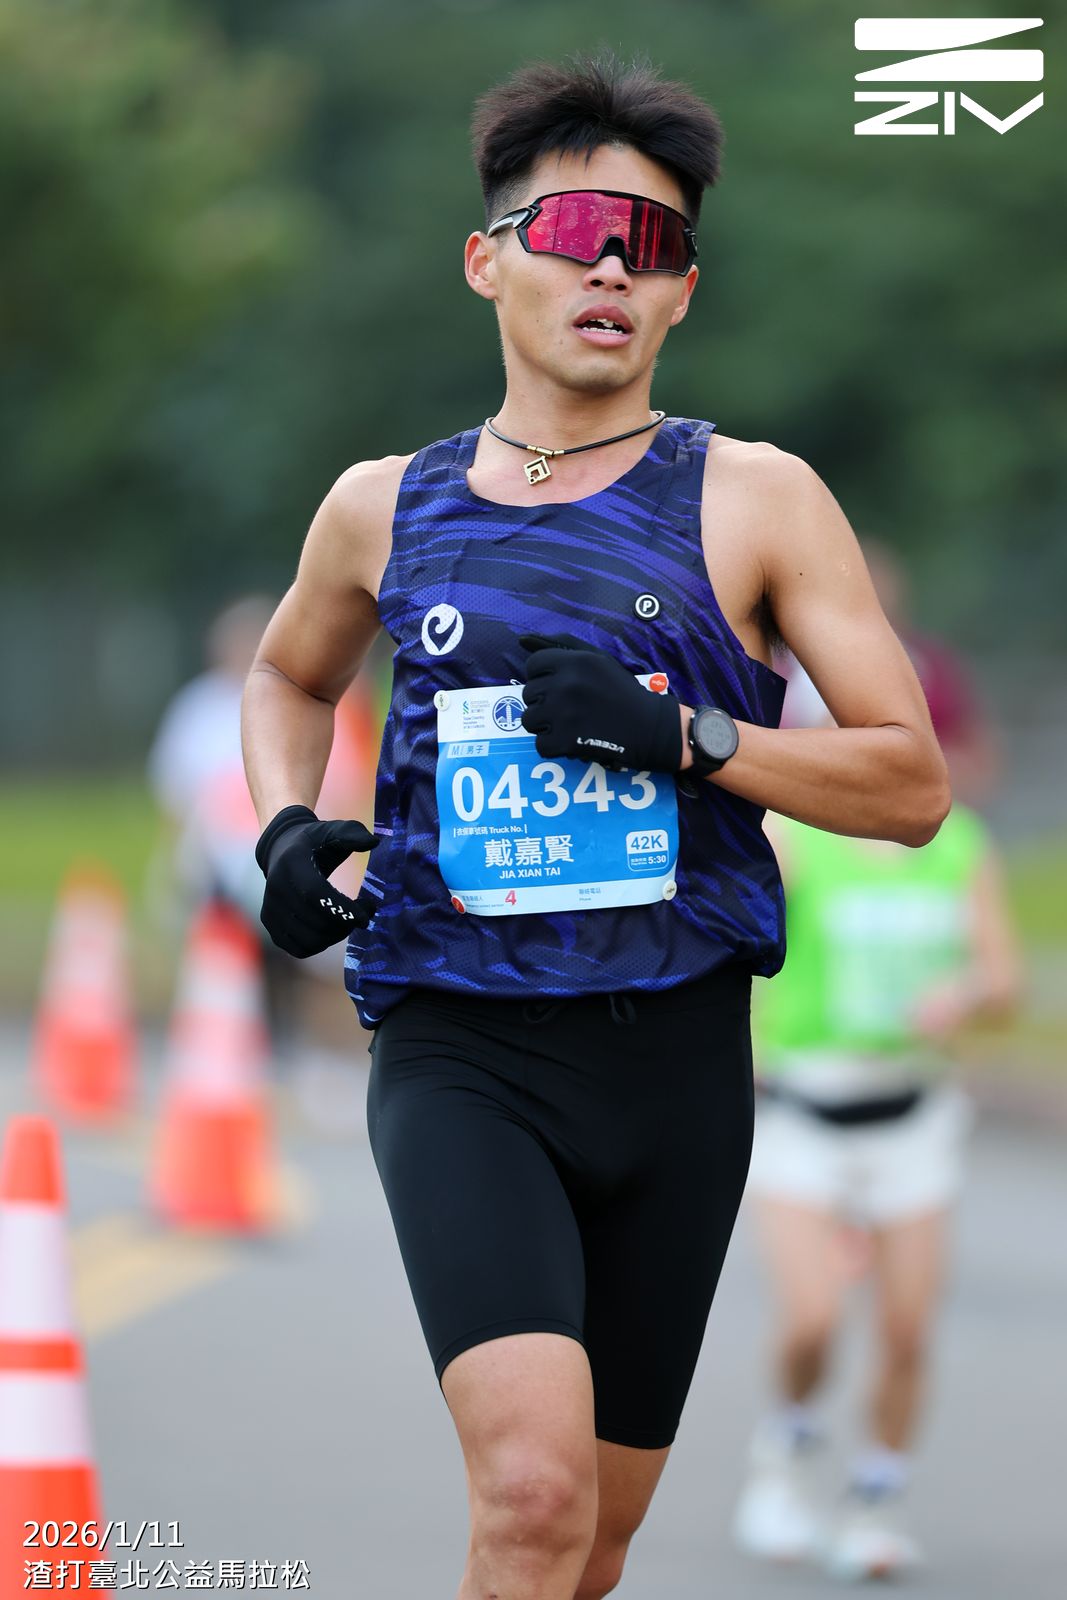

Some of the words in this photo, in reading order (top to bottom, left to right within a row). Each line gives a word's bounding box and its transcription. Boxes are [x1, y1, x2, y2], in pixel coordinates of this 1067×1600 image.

[642, 600, 653, 612] P
[451, 761, 658, 823] 04343
[489, 825, 510, 835] Truck
[510, 824, 524, 834] No.
[630, 834, 663, 850] 42K
[484, 834, 575, 869] 戴嘉賢
[647, 854, 667, 865] 5:30
[499, 867, 516, 879] JIA
[517, 867, 542, 879] XIAN
[544, 866, 561, 877] TAI
[504, 889, 518, 907] 4
